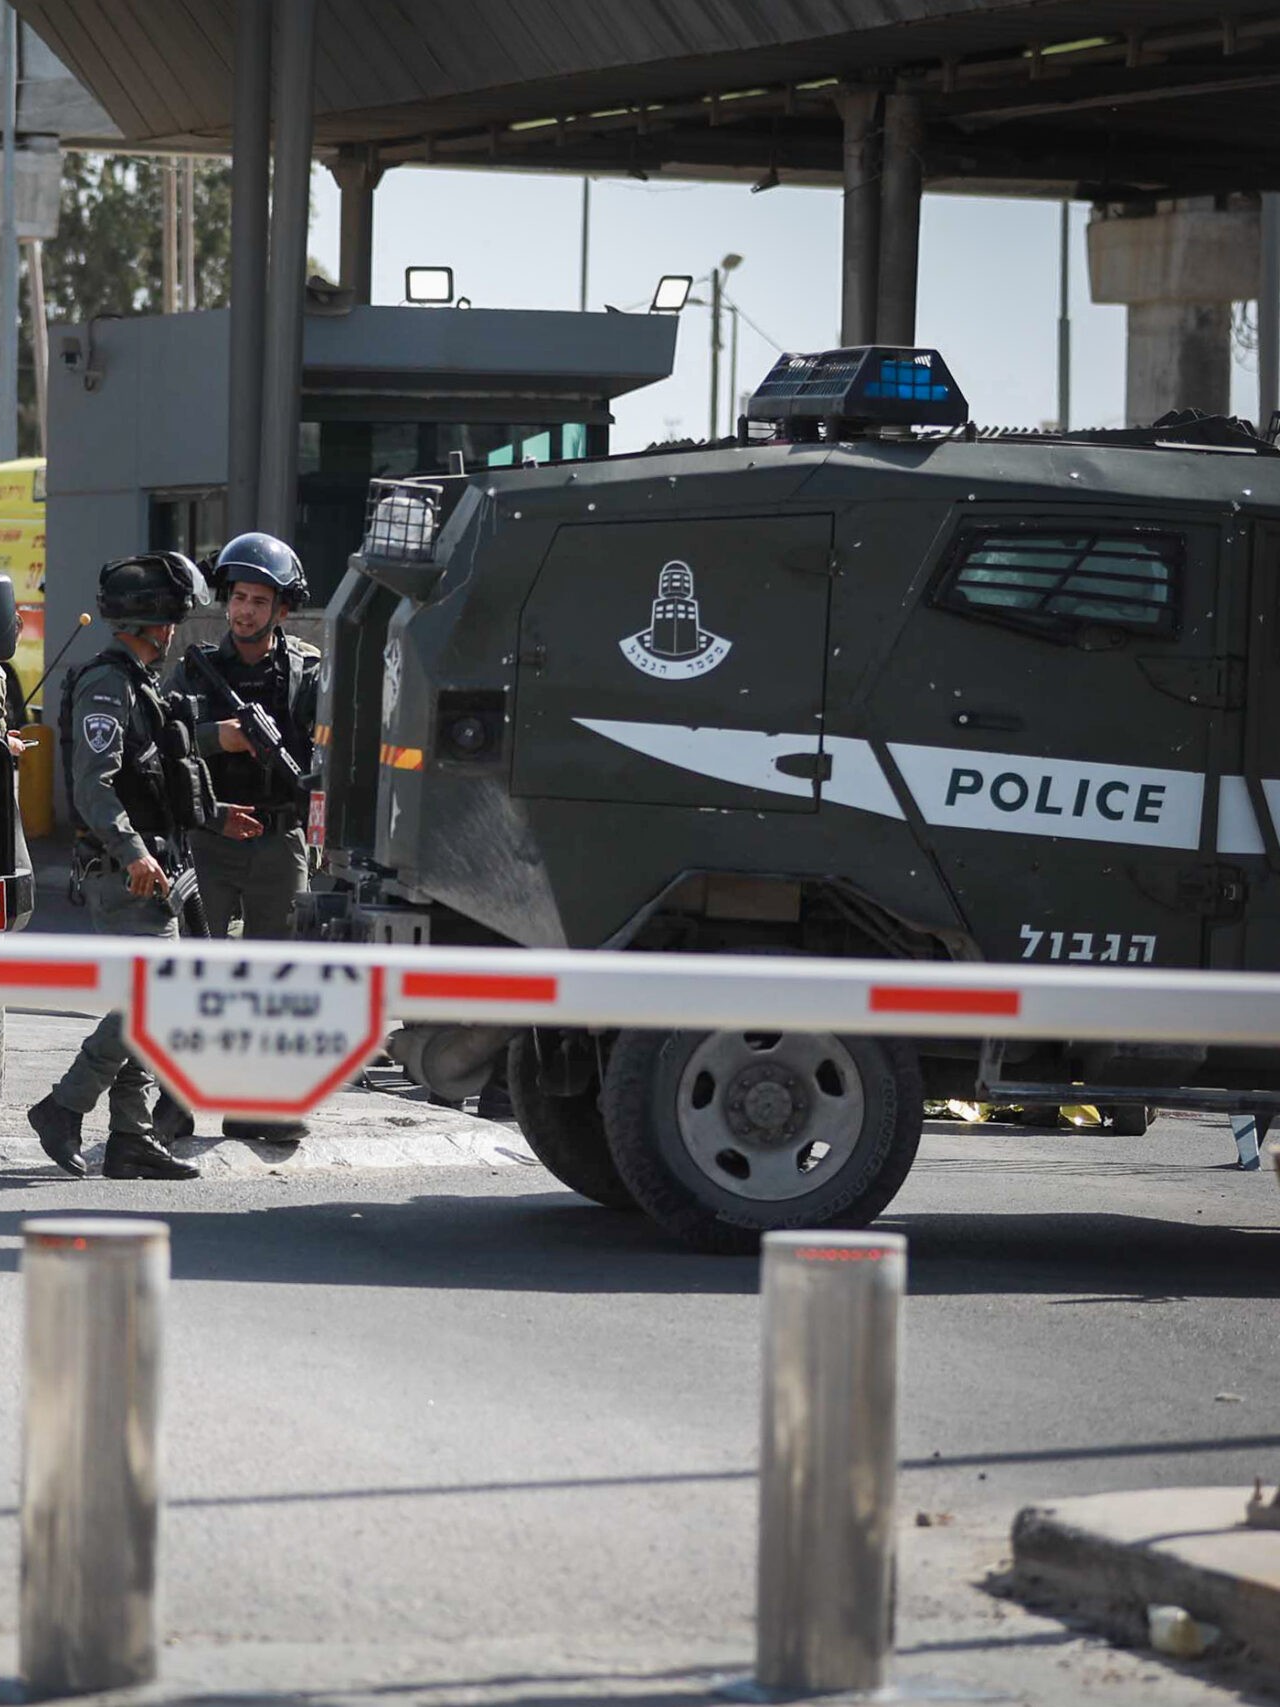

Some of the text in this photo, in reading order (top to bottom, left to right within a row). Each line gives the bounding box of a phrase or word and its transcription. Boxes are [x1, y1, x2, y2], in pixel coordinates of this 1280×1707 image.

[627, 644, 724, 674] משמר הגבול
[944, 767, 1167, 824] POLICE
[1019, 923, 1158, 964] הגבול
